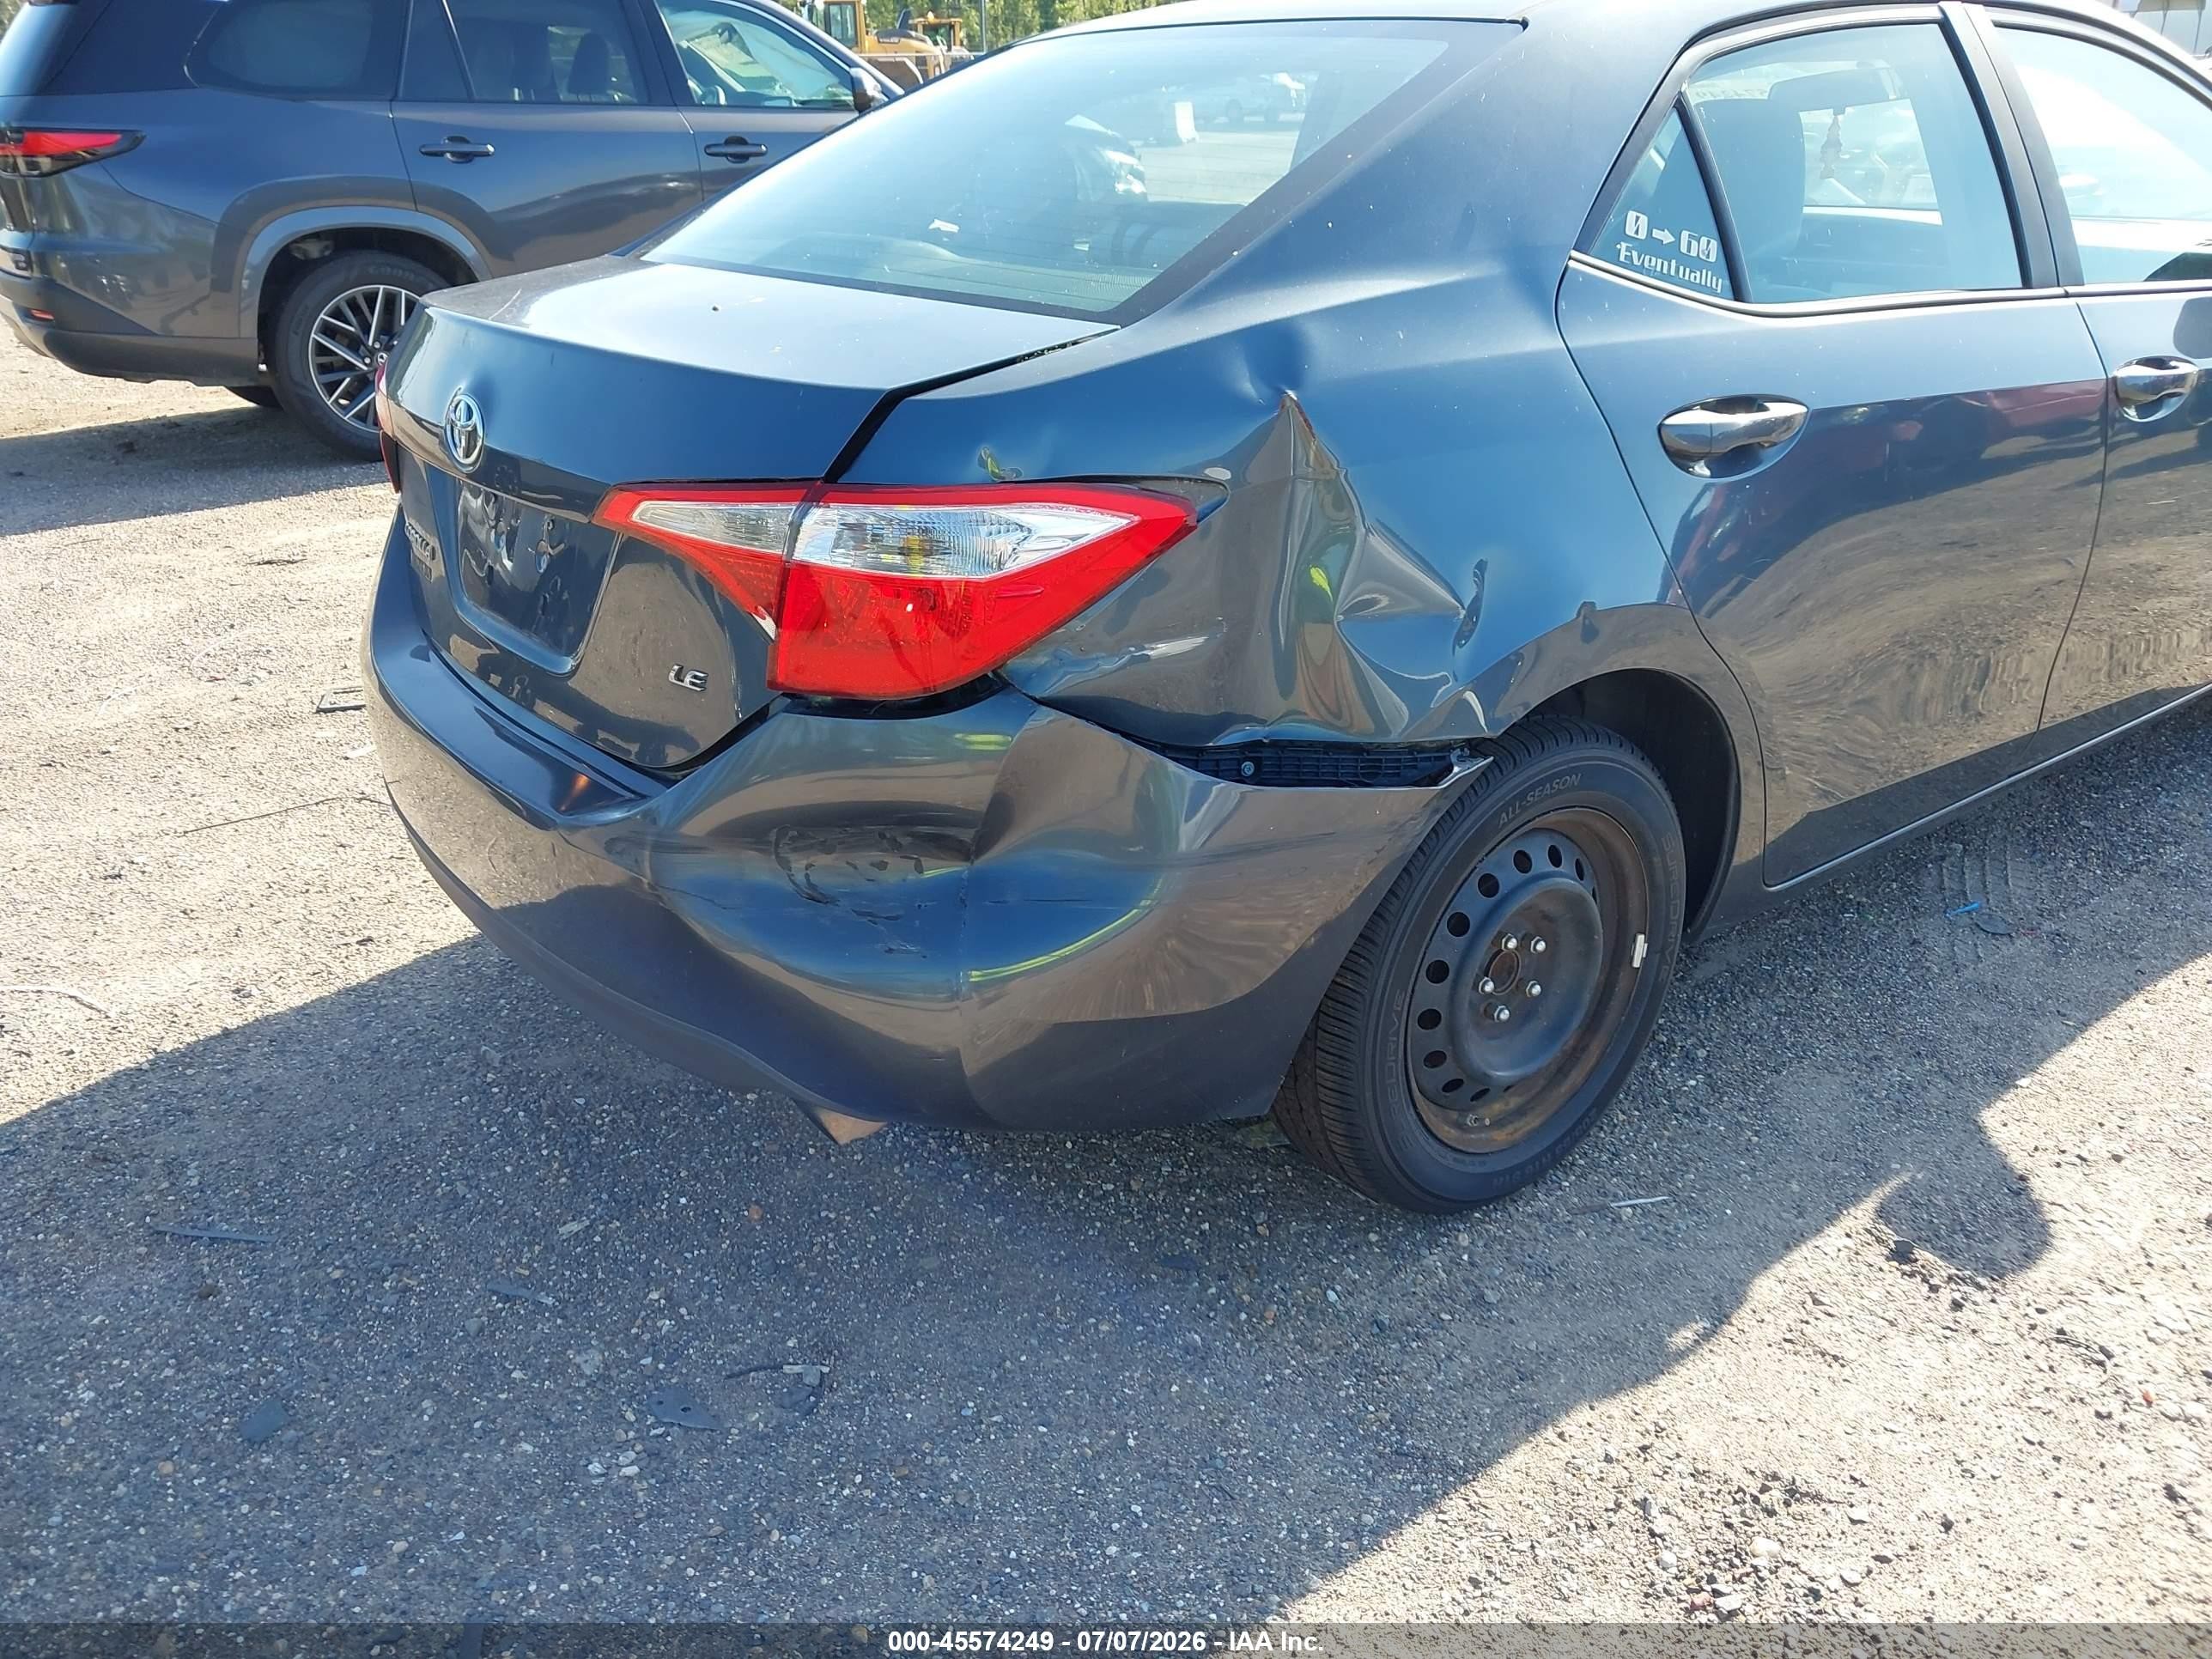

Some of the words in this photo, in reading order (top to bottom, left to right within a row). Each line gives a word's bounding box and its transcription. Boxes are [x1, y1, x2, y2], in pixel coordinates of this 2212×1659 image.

[1625, 210, 1648, 240] 0
[1680, 229, 1717, 263] 60
[1616, 241, 1723, 294] Eventually
[668, 665, 708, 692] LE
[1498, 773, 1583, 829] ALL-SEASON
